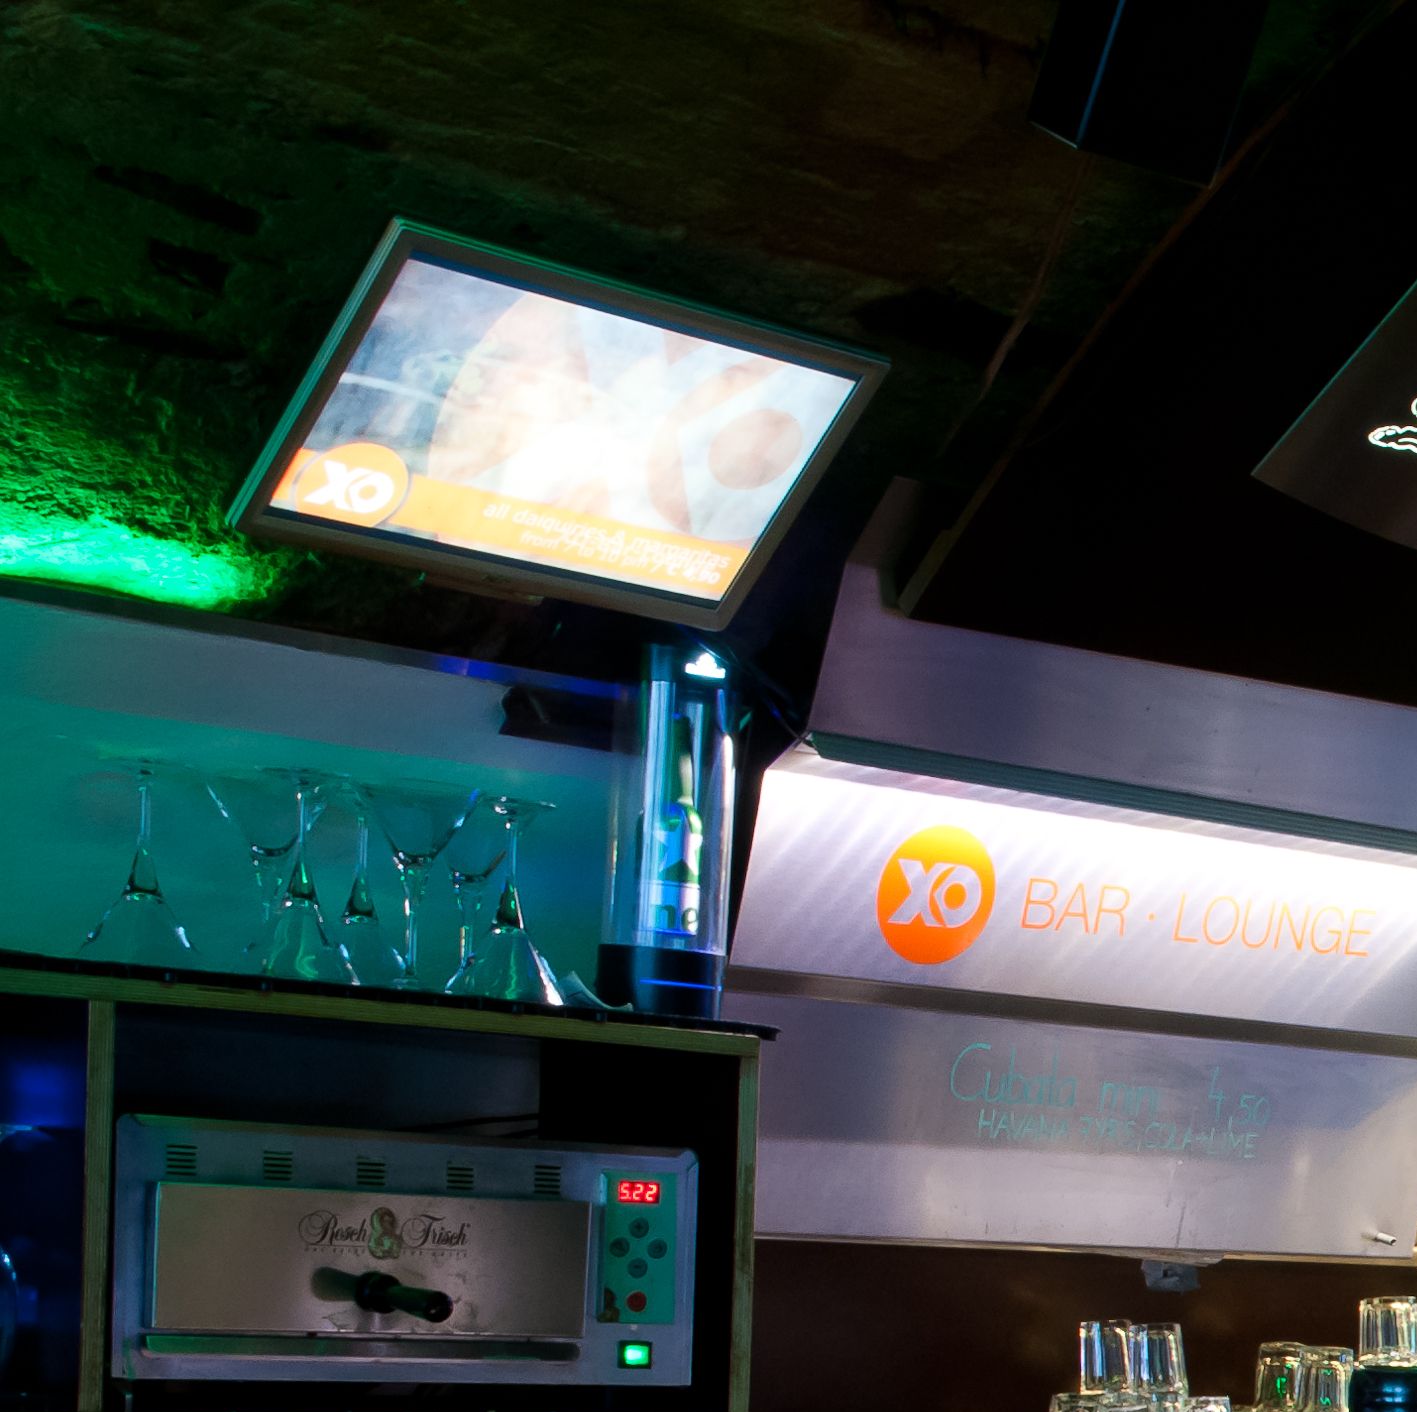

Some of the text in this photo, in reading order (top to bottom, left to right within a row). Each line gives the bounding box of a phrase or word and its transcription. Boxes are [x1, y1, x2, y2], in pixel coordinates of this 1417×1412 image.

[303, 459, 396, 515] XO
[483, 502, 511, 520] all
[516, 530, 559, 551] from
[887, 856, 1377, 956] XO BAR LOUNGE
[977, 1108, 1071, 1141] HAVANA
